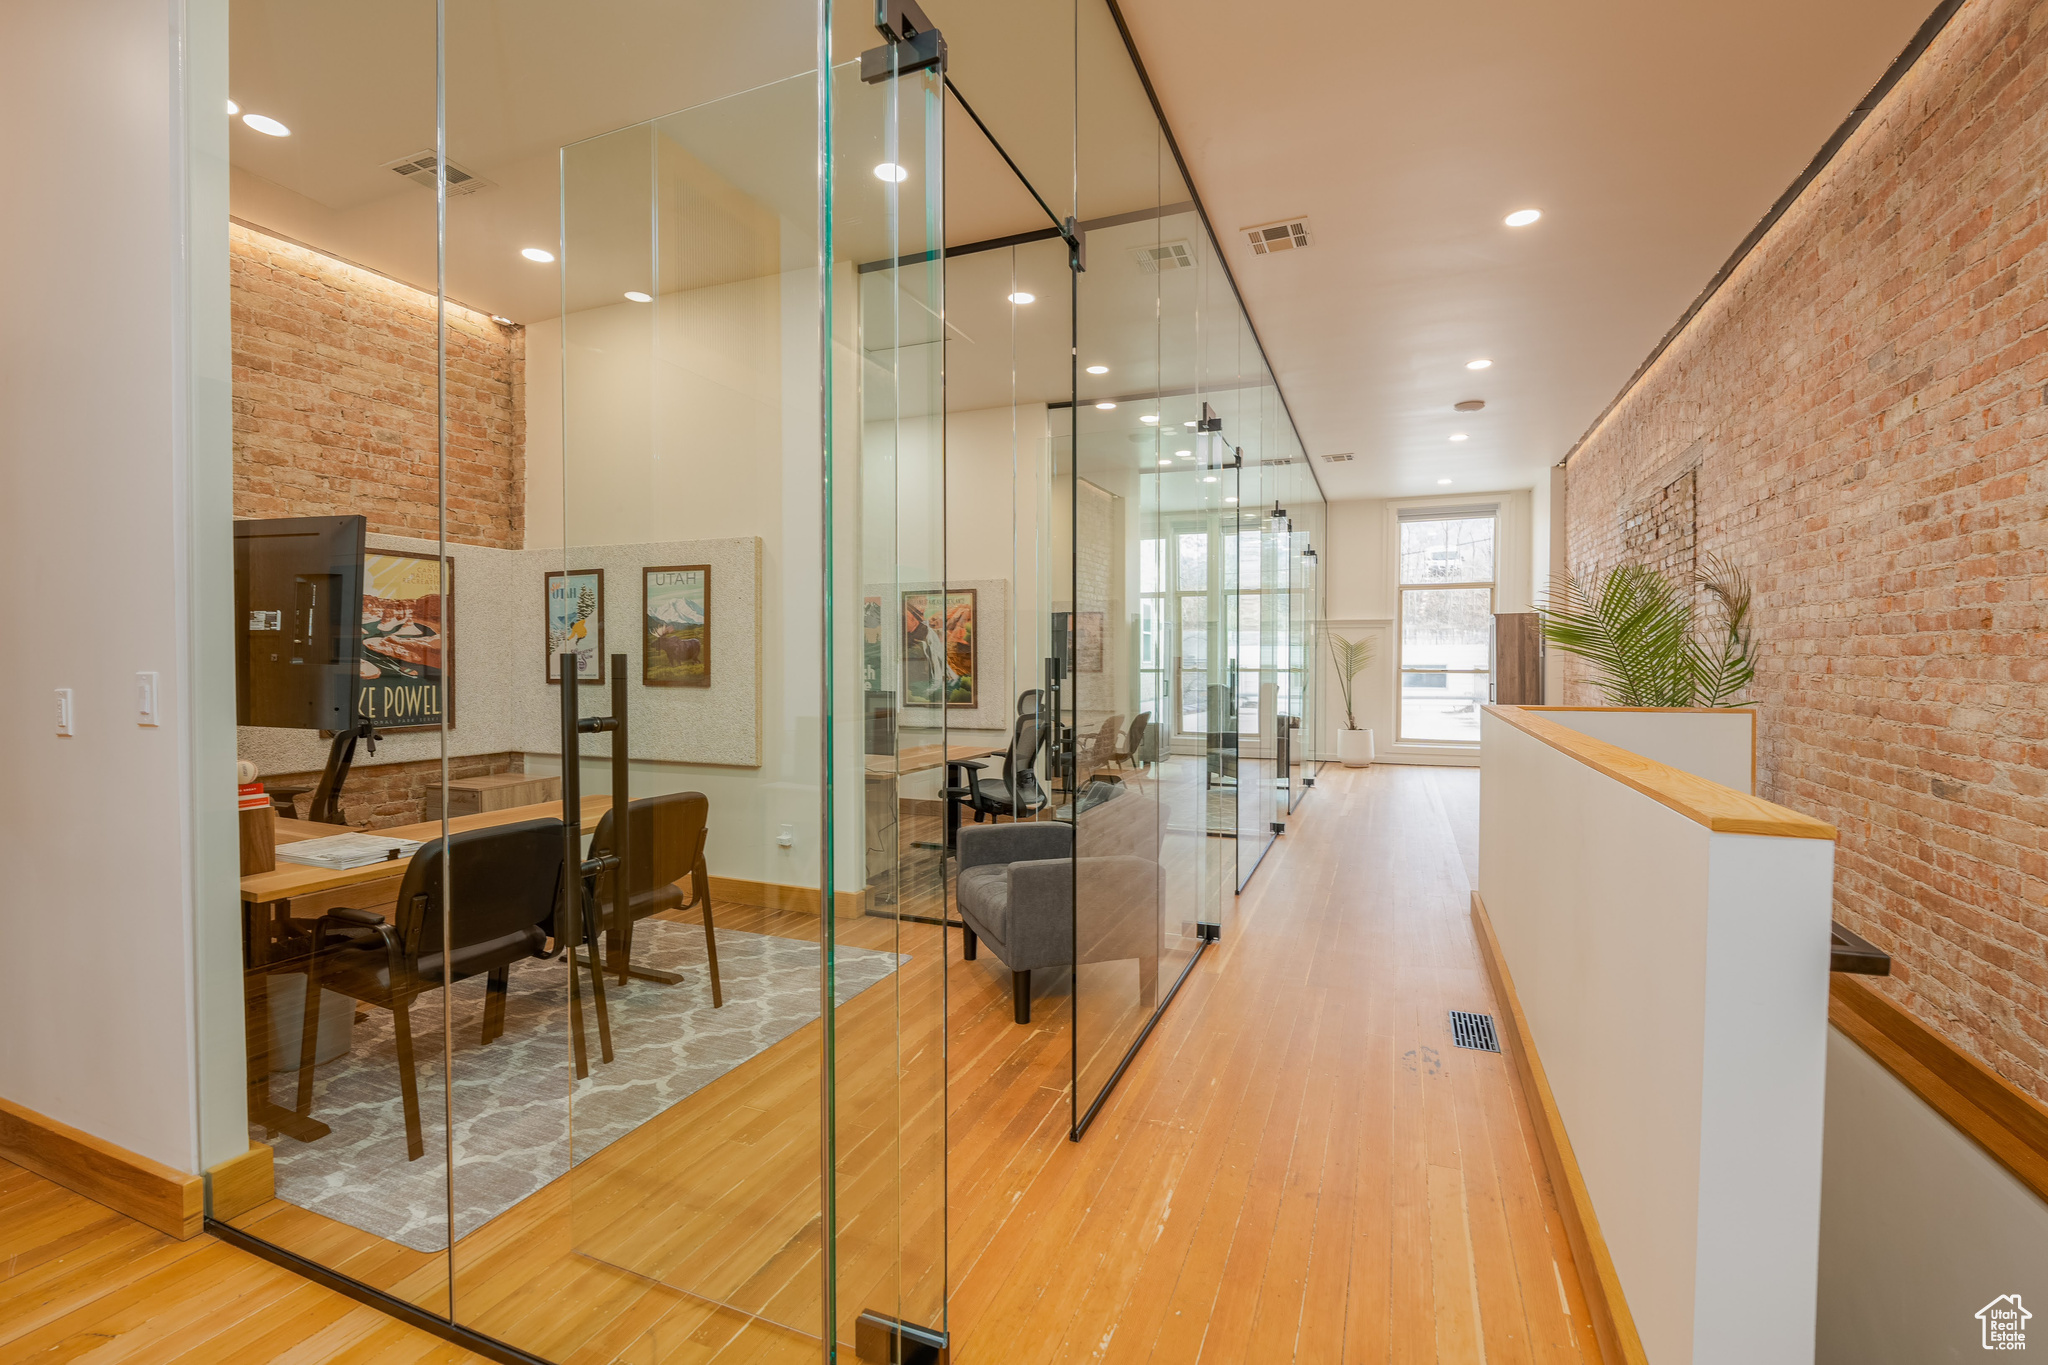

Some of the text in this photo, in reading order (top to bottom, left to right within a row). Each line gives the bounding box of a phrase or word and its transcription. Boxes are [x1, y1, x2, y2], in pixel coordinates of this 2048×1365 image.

[402, 577, 440, 585] RECREATIO
[411, 572, 440, 580] NATION
[655, 572, 696, 586] UTAH
[358, 685, 442, 719] KE POWEL
